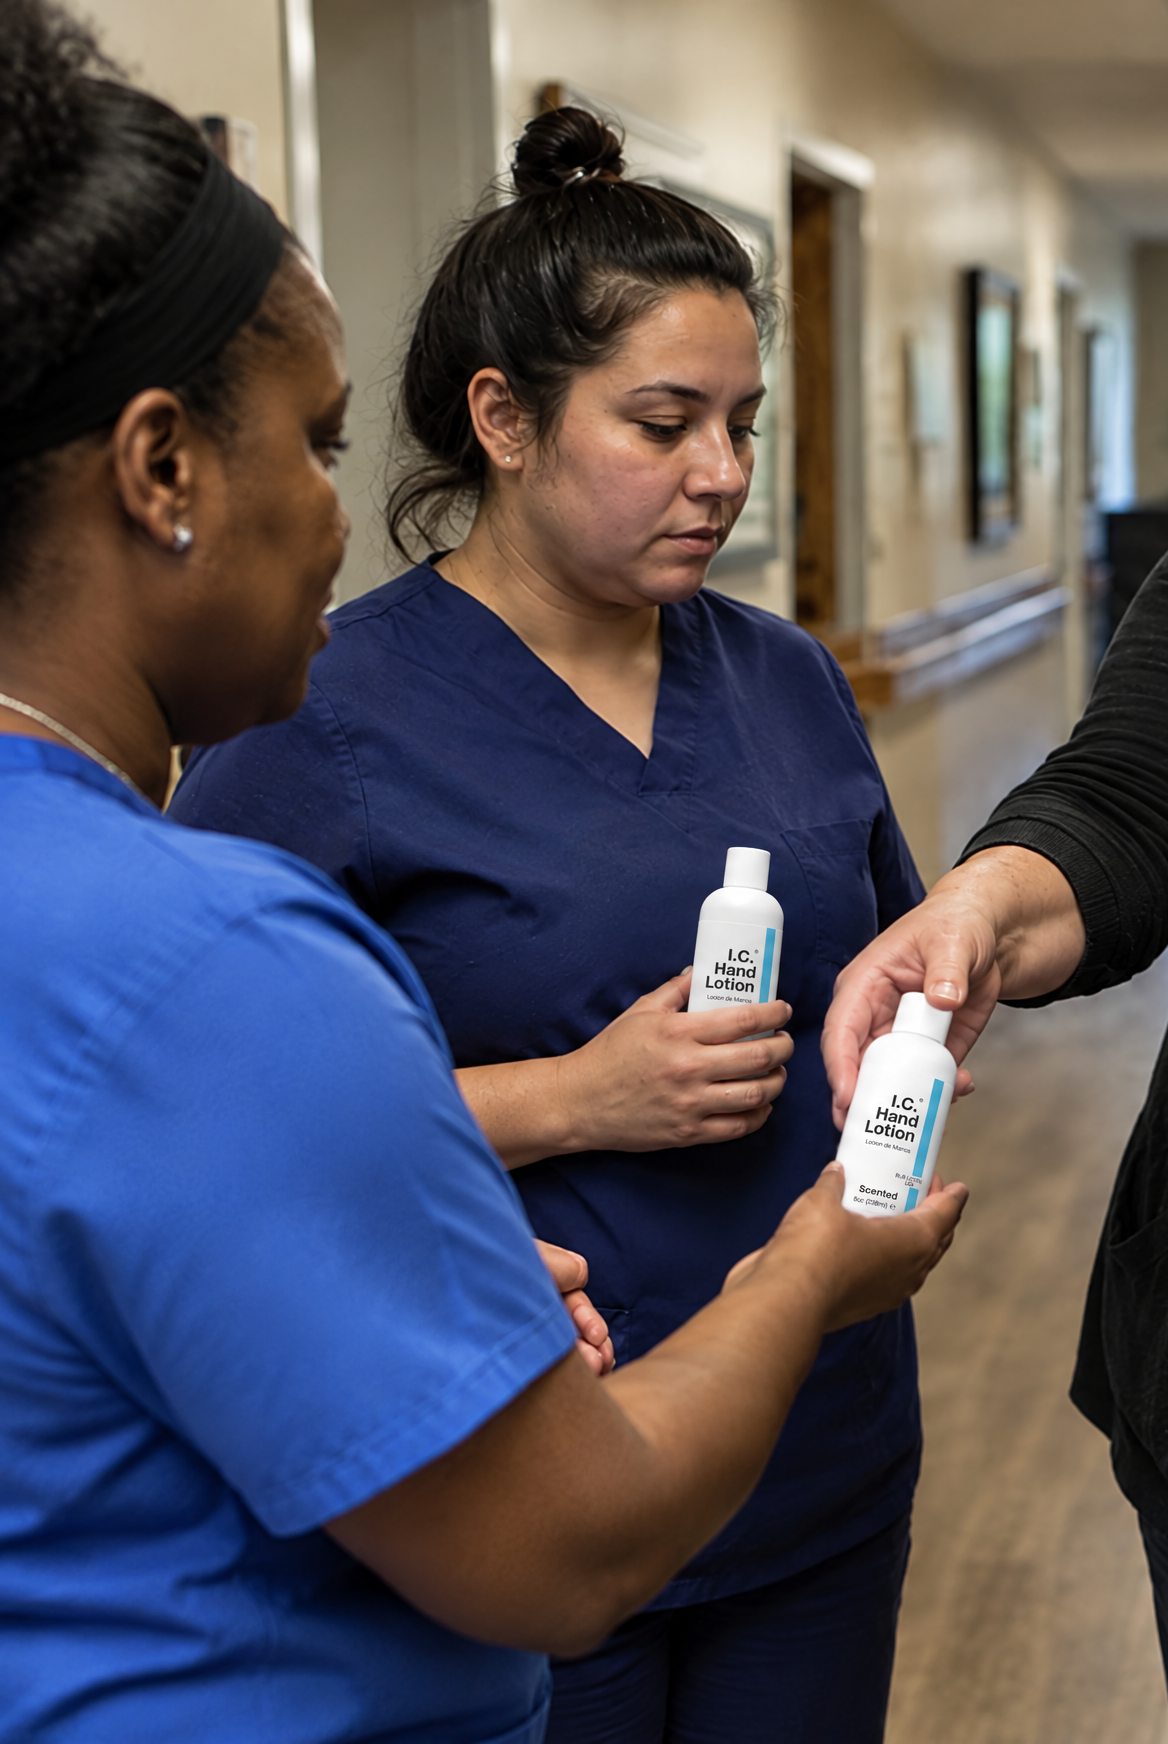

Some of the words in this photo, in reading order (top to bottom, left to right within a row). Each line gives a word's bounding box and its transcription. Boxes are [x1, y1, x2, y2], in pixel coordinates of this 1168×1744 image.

[715, 962, 756, 978] Hand
[705, 976, 754, 992] Lotion
[876, 1107, 919, 1128] Hand
[865, 1120, 915, 1142] Lotion
[859, 1185, 899, 1200] Scented
